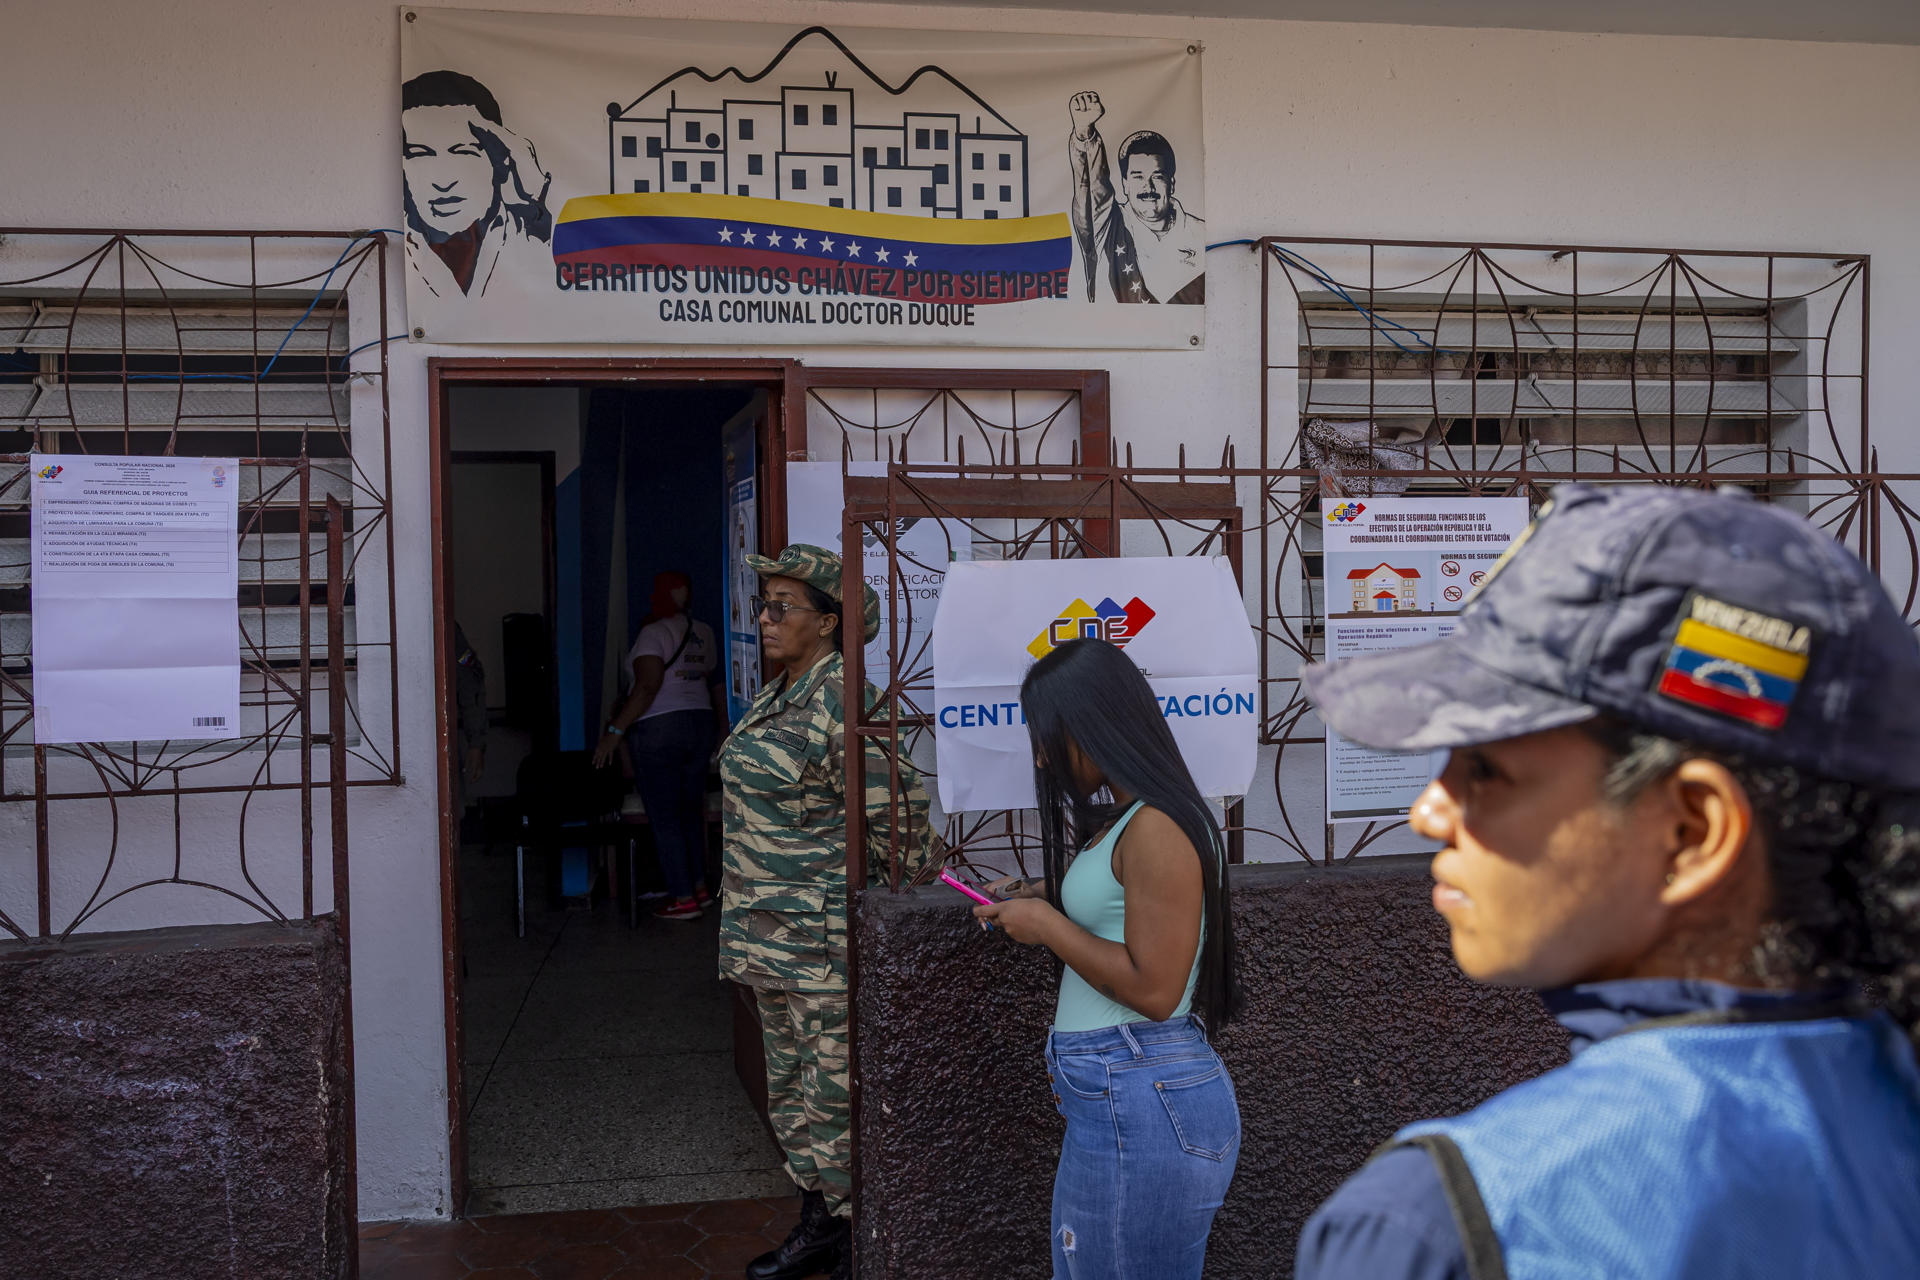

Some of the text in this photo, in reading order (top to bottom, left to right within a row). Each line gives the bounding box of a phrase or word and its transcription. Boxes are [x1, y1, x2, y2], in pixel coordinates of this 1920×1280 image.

[556, 260, 1068, 299] CERRITOS UNIDOS CHÁVEZ POR SIEMPRE
[659, 299, 975, 327] CASA COMUNAL DOCTOR DUQUE
[1333, 508, 1359, 517] CNE
[1374, 513, 1398, 522] NORMAS
[1398, 513, 1406, 522] DE
[1438, 513, 1468, 521] FUNCIONES
[1468, 513, 1476, 521] DE
[1476, 513, 1487, 521] LOS
[1369, 524, 1398, 533] EFECTIVOS
[1398, 524, 1405, 533] DE
[1405, 524, 1413, 533] LA
[1413, 523, 1444, 532] OPERACIÓN
[1444, 523, 1473, 532] REPÚBLICA
[1478, 524, 1485, 532] DE
[1485, 524, 1492, 532] LA
[1350, 535, 1393, 543] COORDINADORA
[1398, 535, 1405, 543] EL
[1405, 534, 1444, 543] COORDINADOR
[1445, 534, 1454, 542] DEL
[1454, 534, 1475, 542] CENTRO
[1476, 534, 1483, 542] DE
[1483, 533, 1511, 542] VOTACIÓN
[884, 588, 940, 600] EECTOR
[1691, 595, 1811, 656] VENEZUELA
